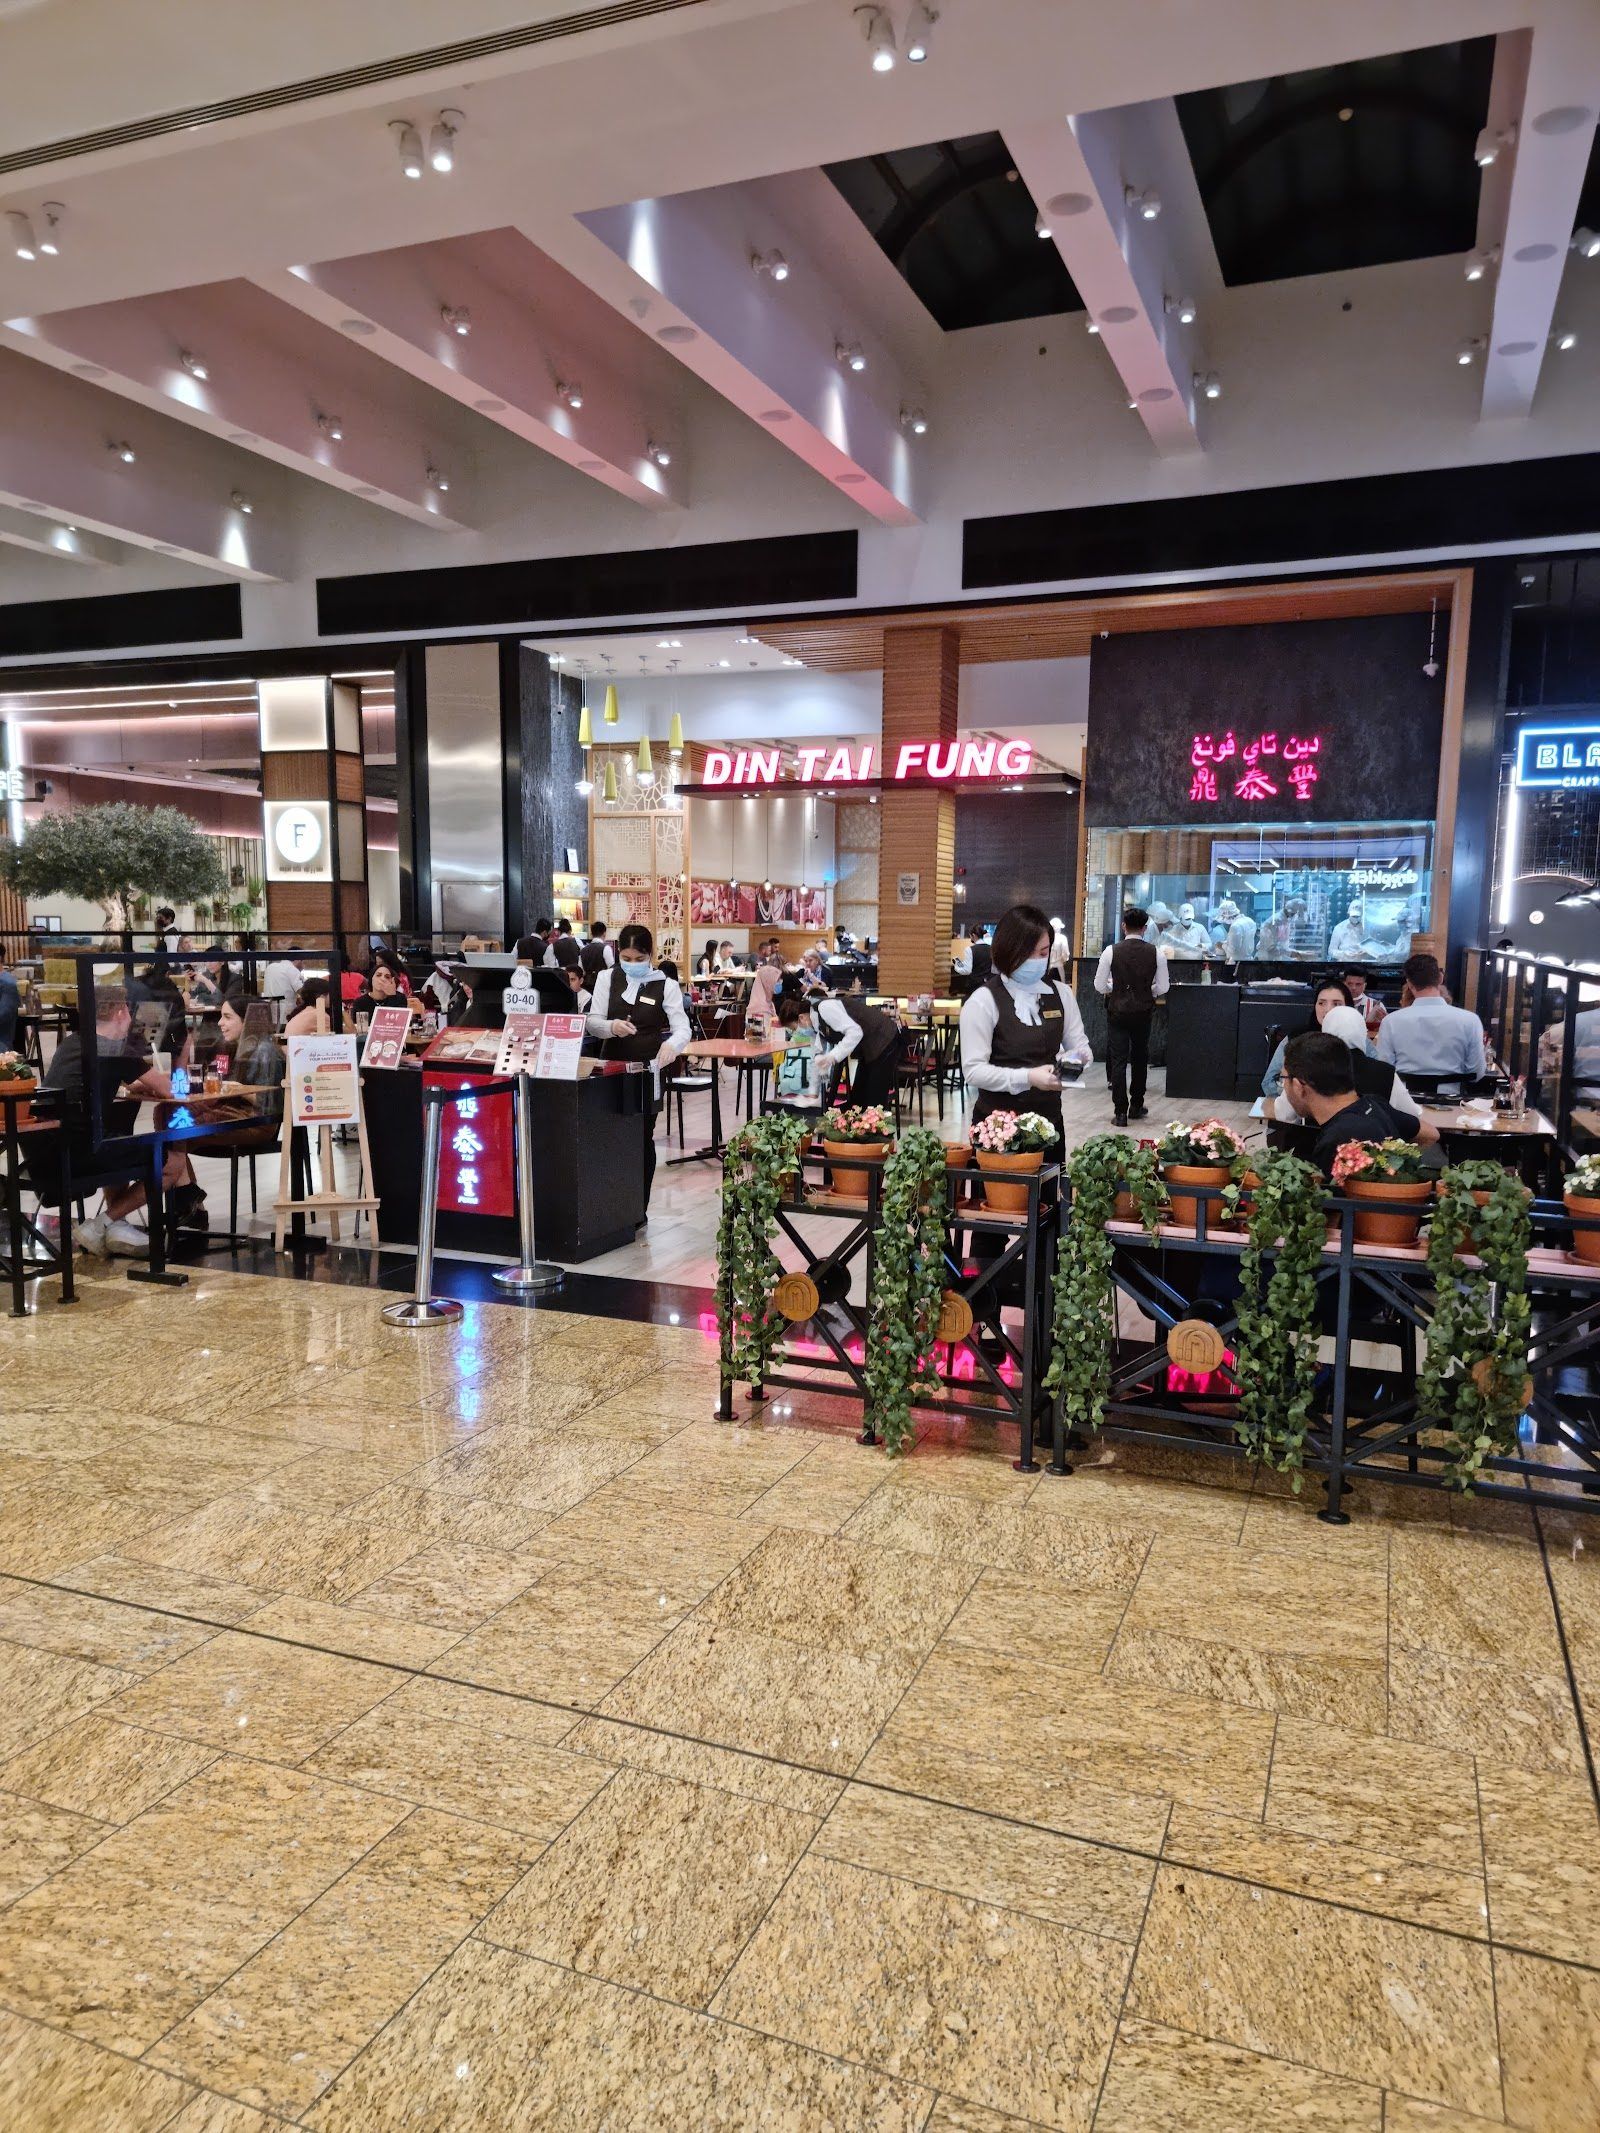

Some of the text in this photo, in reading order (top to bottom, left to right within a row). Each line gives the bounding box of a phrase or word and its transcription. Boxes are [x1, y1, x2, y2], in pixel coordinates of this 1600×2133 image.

[702, 740, 1032, 785] DIN TAI FUNG
[1191, 732, 1319, 766] دين تاي فونغ
[506, 993, 535, 1006] 30-40
